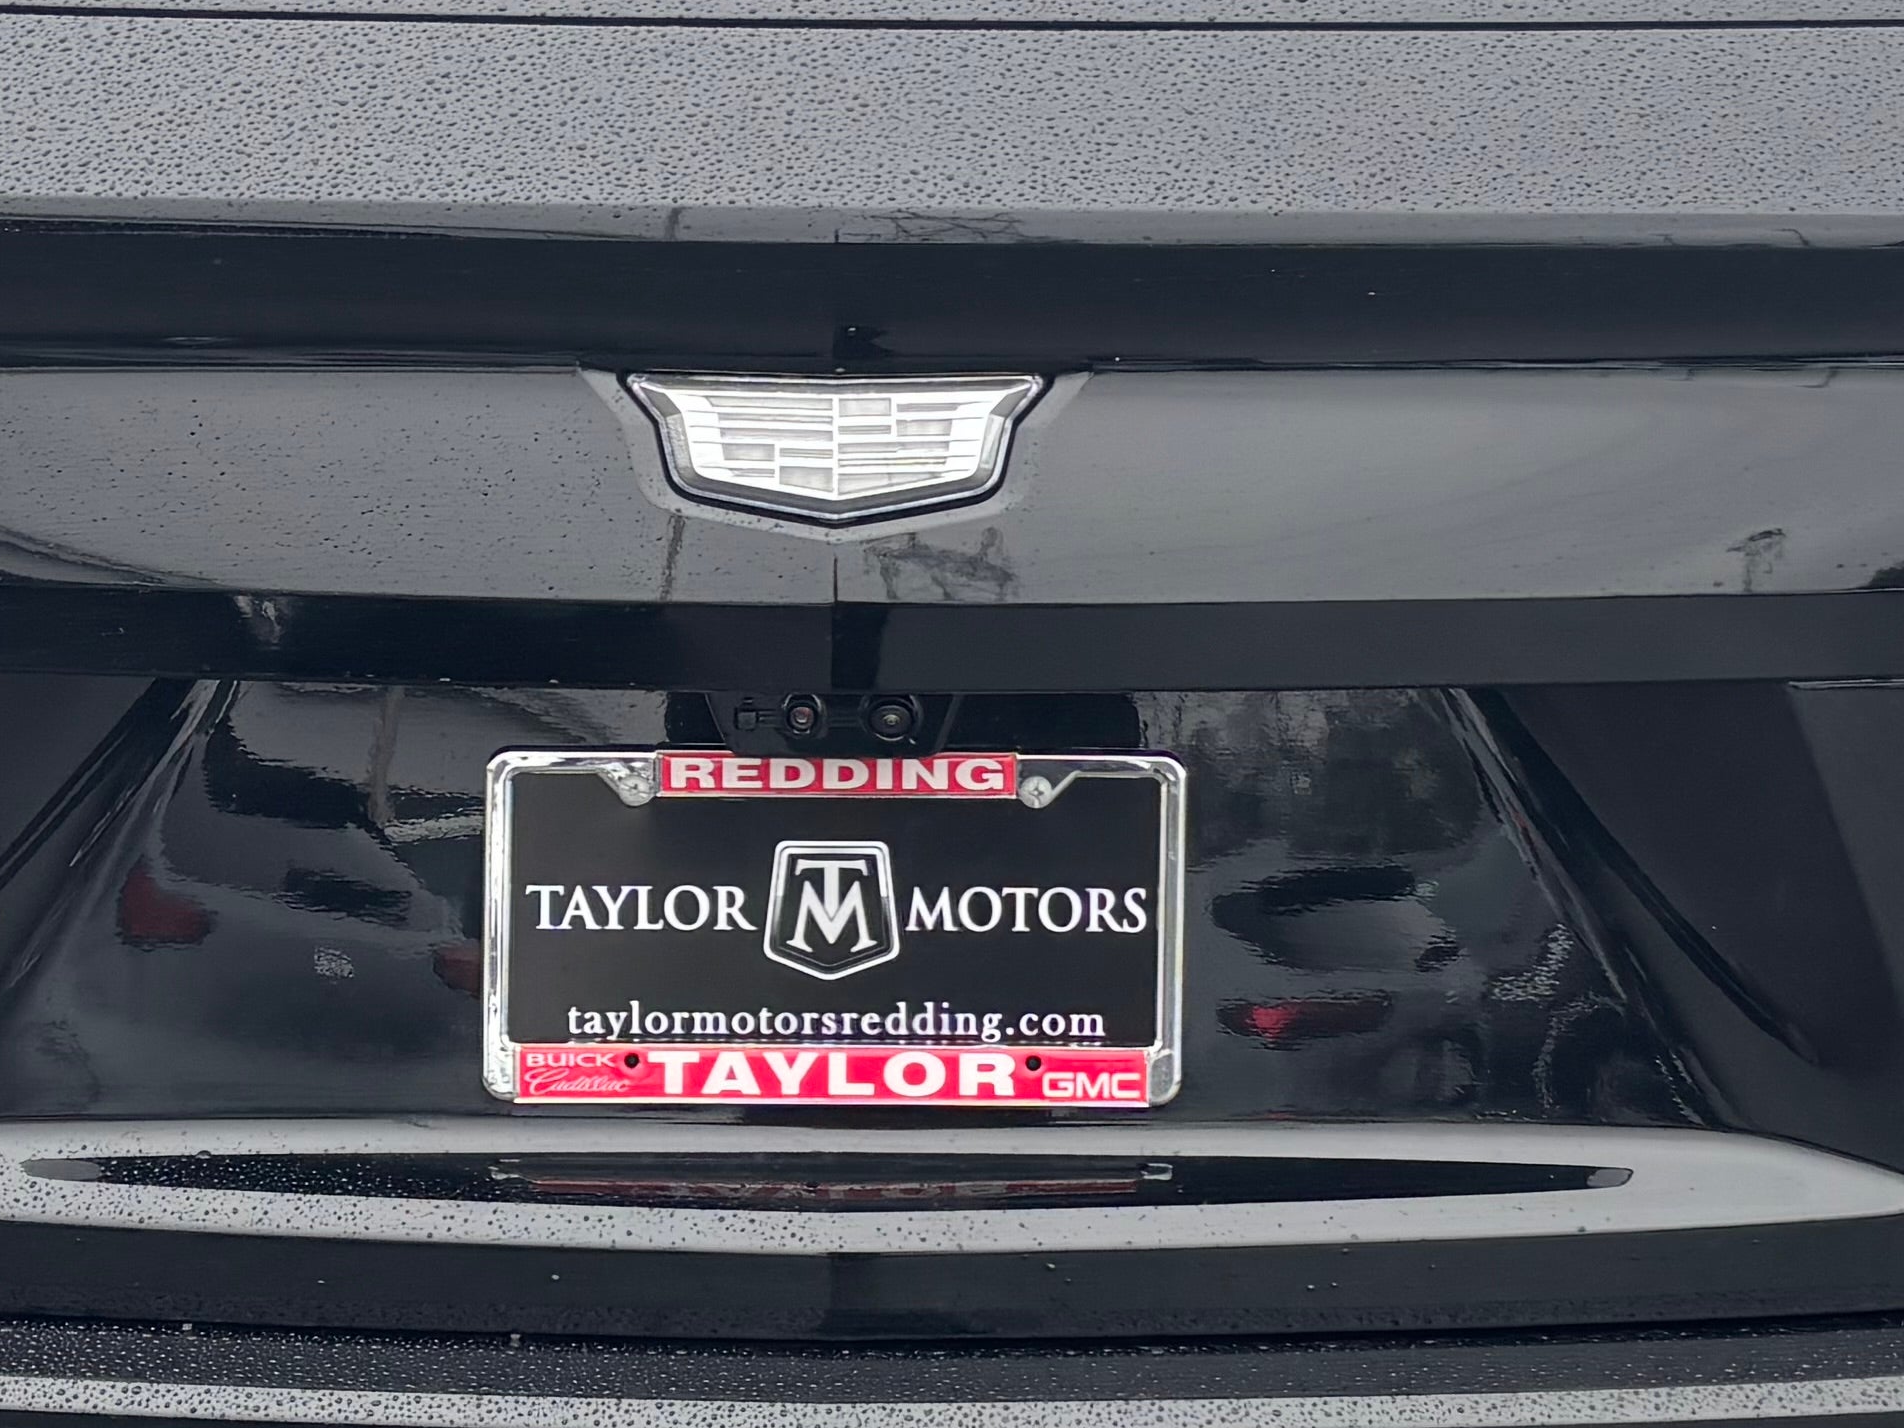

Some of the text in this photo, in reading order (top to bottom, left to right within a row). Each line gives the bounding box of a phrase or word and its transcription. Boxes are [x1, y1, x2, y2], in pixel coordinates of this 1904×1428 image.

[669, 756, 1007, 791] REDDING
[525, 884, 1148, 935] TAYLOR MOTORS
[567, 1001, 1106, 1041] taylormotorsredding.com
[525, 1052, 616, 1068] BUICK
[647, 1051, 1016, 1096] TAYLOR
[523, 1067, 631, 1096] Cadillac
[1042, 1072, 1141, 1099] GMC
